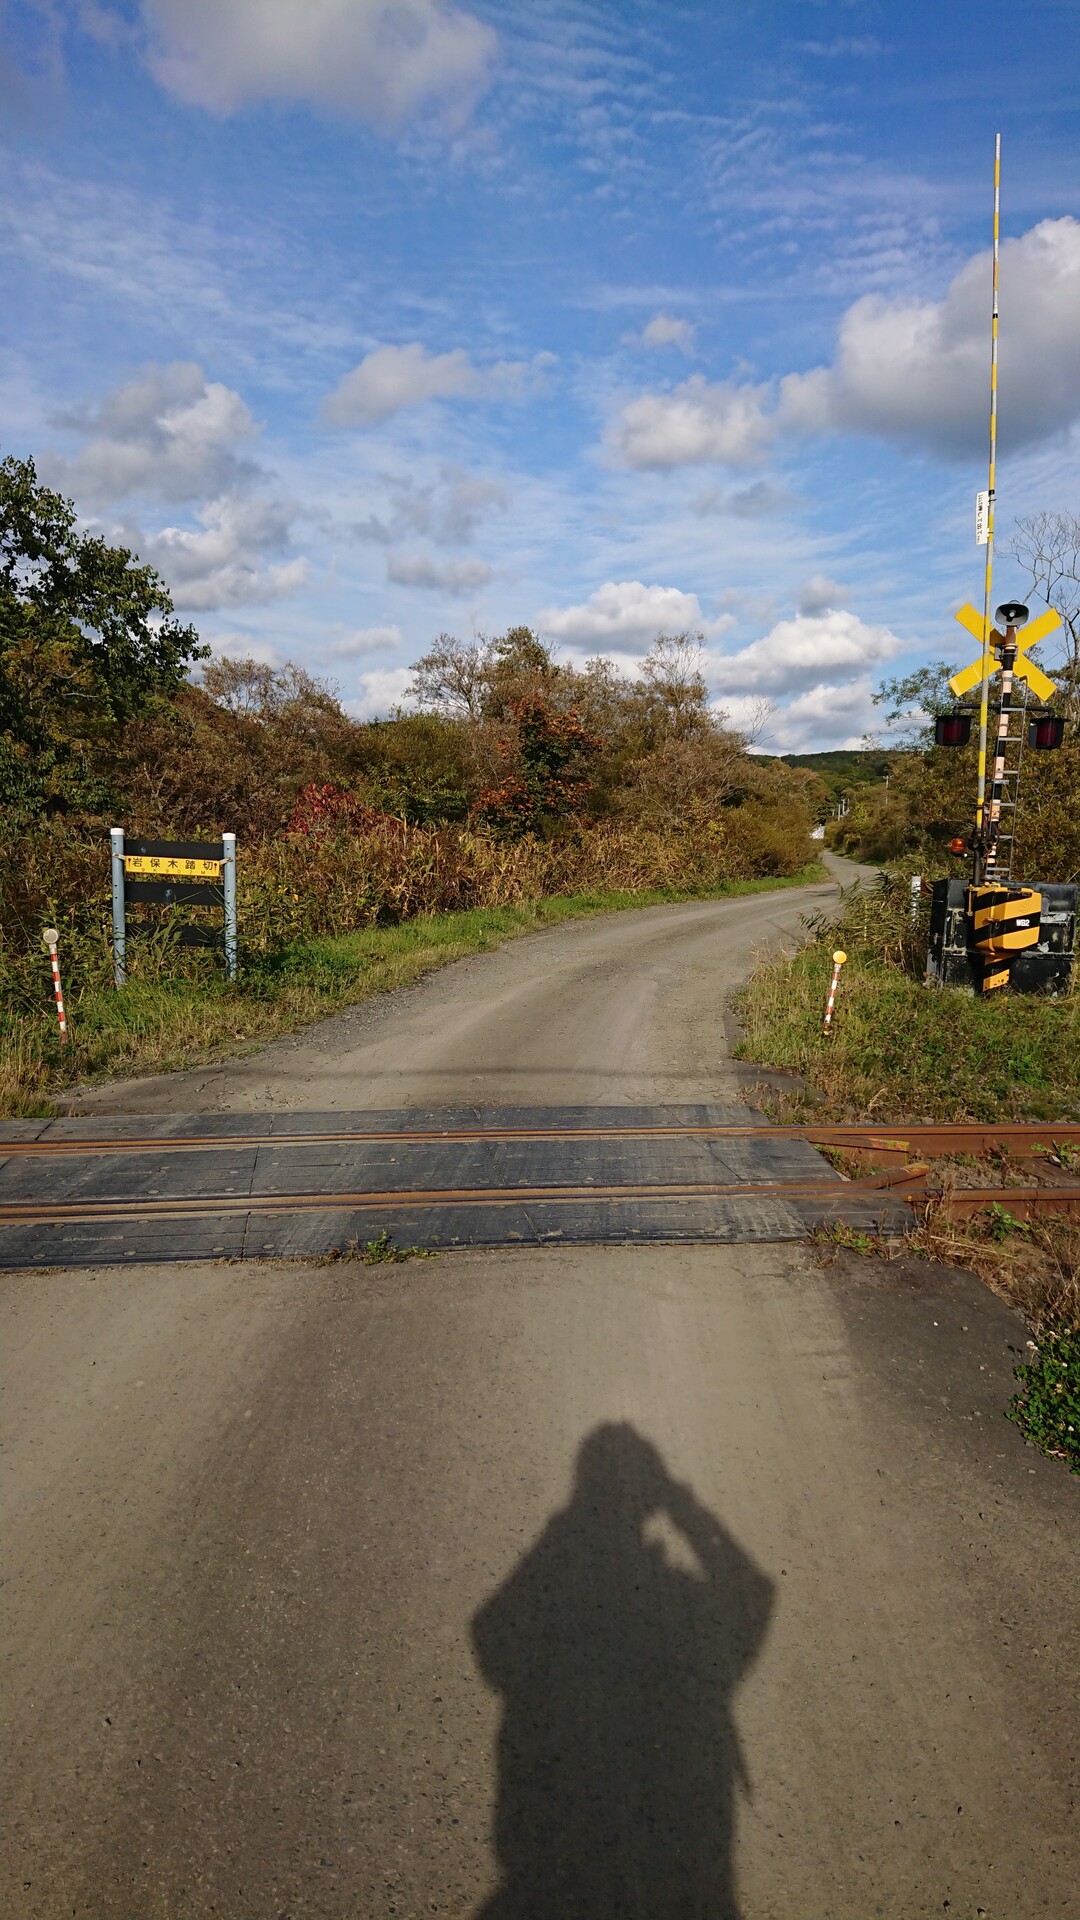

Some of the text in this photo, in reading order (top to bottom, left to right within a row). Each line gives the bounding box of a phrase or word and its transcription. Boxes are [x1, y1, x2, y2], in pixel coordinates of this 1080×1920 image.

[132, 857, 214, 870] 岩保木踏切
